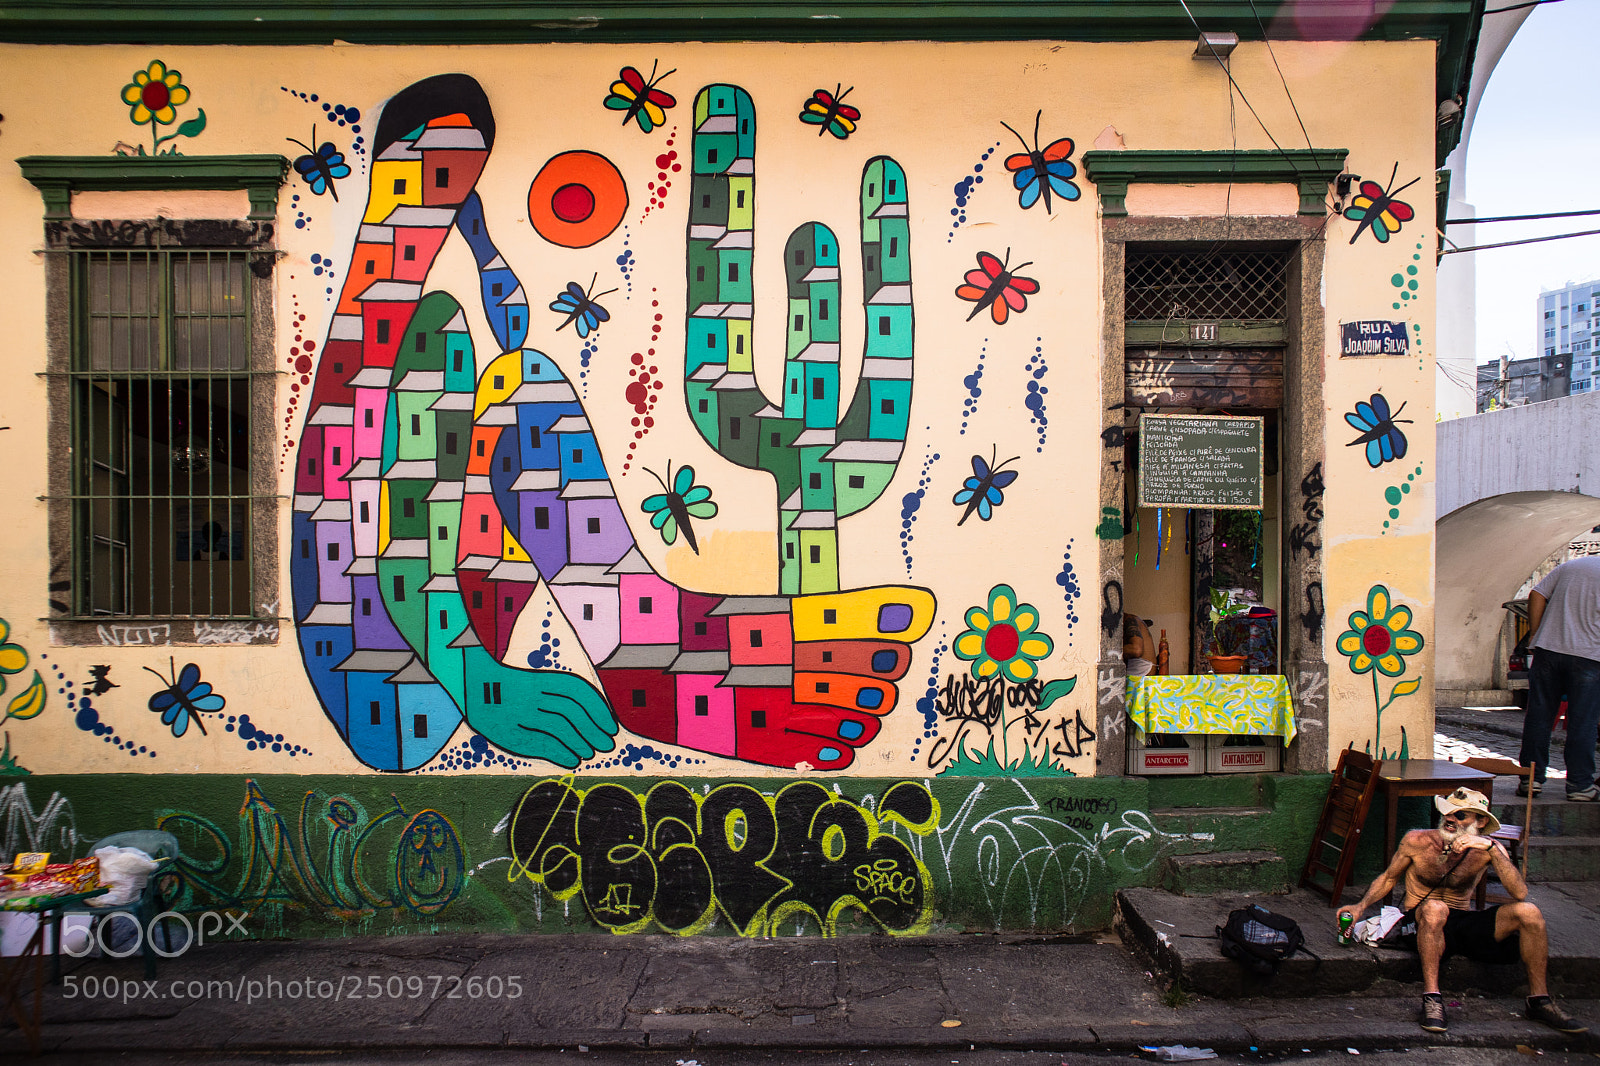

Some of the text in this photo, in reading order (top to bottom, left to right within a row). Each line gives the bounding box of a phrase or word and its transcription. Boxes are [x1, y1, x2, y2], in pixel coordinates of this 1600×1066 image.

[1195, 325, 1215, 340] 141
[1360, 322, 1393, 335] RUA
[1384, 336, 1407, 353] SILVA
[1170, 462, 1210, 470] MILANESA
[1146, 756, 1189, 765] ANTARCTICA
[1223, 754, 1264, 765] ANTARCTICA
[1065, 816, 1094, 830] 2016
